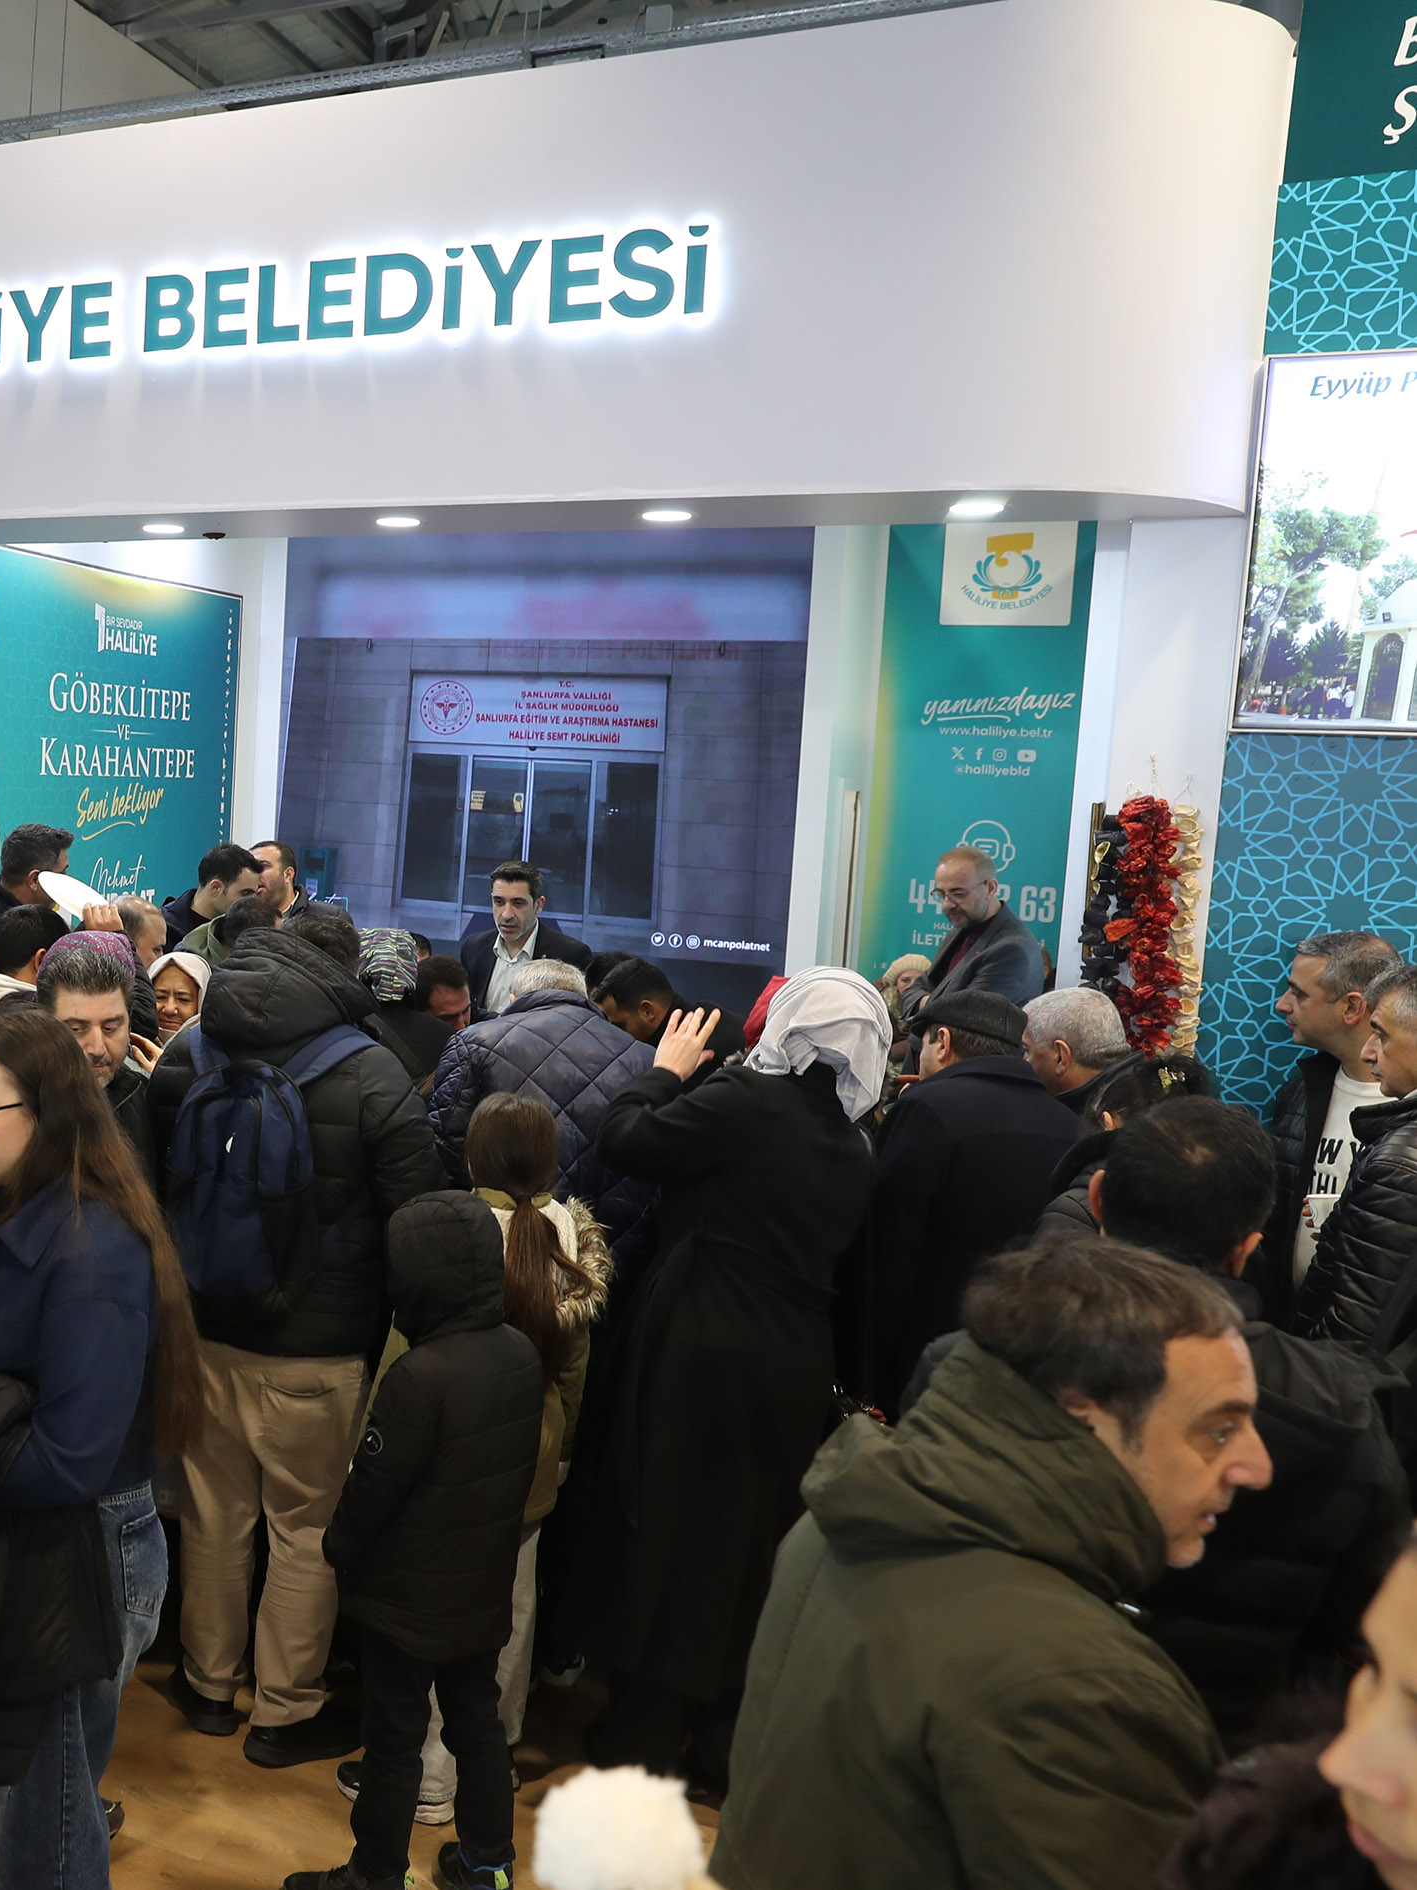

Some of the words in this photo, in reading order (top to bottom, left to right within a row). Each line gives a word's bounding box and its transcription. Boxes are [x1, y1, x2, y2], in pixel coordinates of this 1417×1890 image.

[1309, 371, 1392, 400] Eyyüp
[1400, 371, 1417, 393] P
[558, 680, 575, 688] T.C.
[49, 672, 191, 721] GÖBEKLİTEPE
[521, 690, 570, 700] ŞANLIURFA
[573, 691, 612, 701] VALİLİĞİ
[514, 701, 523, 710] İL
[525, 701, 559, 711] SAĞLIK
[560, 702, 620, 713] MÜDÜRLÜĞÜ
[475, 712, 519, 724] ŞANLIURFA
[520, 712, 548, 724] EĞİTİM
[550, 715, 561, 725] VE
[562, 715, 610, 727] ARAŞTIRMA
[611, 717, 659, 729] HASTANESİ
[116, 724, 131, 741] VE
[508, 729, 545, 741] HALİLİYE
[547, 731, 569, 742] SEMT
[570, 732, 621, 744] POLİKLİNİĞİ
[938, 725, 1054, 739] www.haliliye.bel.tr
[39, 737, 195, 779] KARAHANTEPE
[954, 764, 1031, 778] @haliliyebld
[76, 786, 109, 829] Seni
[110, 782, 165, 825] bekliyor
[909, 878, 943, 915] 44
[1019, 885, 1057, 923] 63
[933, 922, 953, 931] HAL
[703, 939, 771, 952] mcanpolatnet
